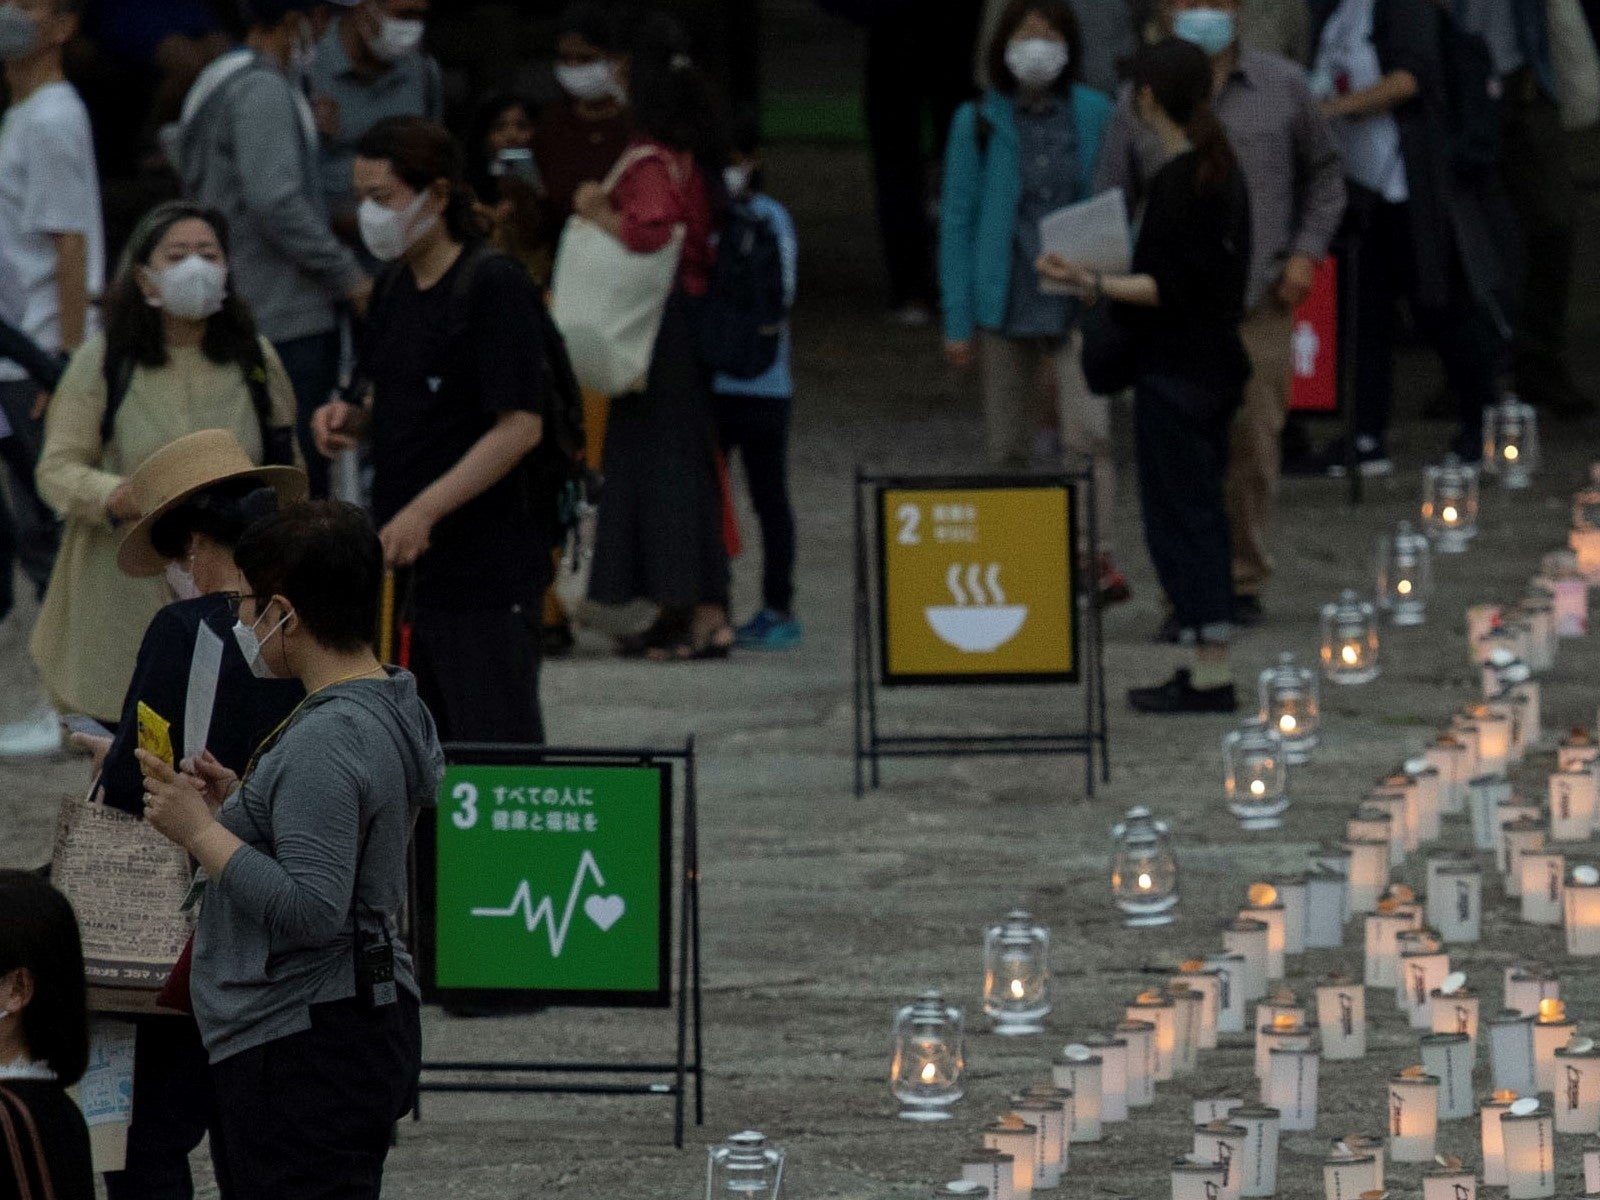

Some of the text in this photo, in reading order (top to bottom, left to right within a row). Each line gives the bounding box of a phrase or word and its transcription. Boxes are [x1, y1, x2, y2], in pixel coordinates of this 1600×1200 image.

[897, 503, 921, 544] 2
[452, 782, 478, 830] 3
[492, 787, 594, 806] すべての人に
[131, 889, 166, 899] CASIO
